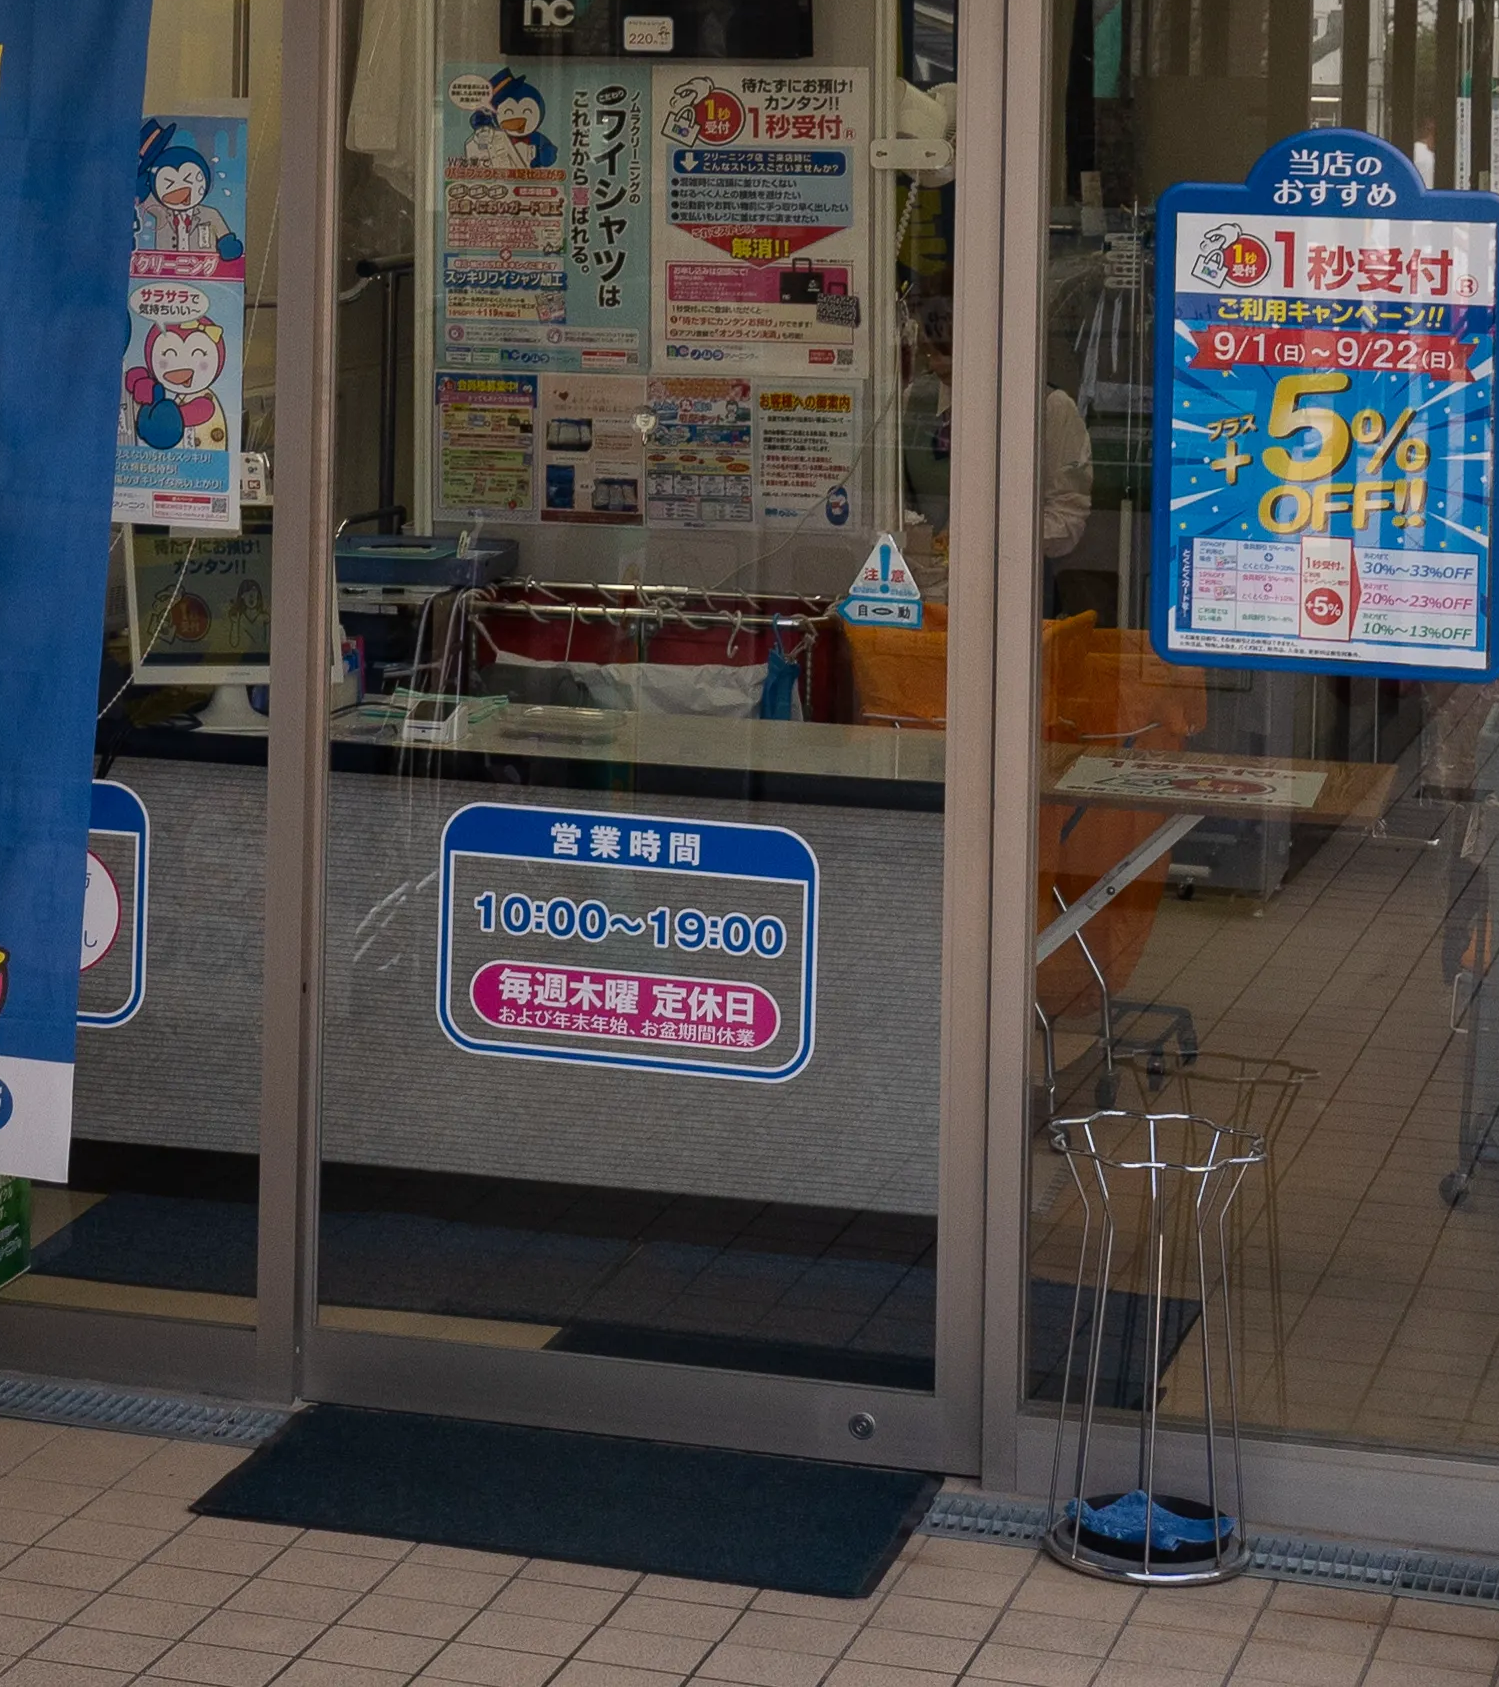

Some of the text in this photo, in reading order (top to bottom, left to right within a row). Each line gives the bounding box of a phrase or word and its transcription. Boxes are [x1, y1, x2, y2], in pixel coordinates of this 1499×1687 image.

[741, 78, 853, 94] 待たずにお預け!
[765, 96, 839, 111] カンタン!!
[630, 91, 641, 204] ノムラクリーニングの
[703, 163, 838, 173] こんなストレスございませんか?
[1289, 150, 1382, 177] 当店の
[571, 91, 590, 273] これだから喜ばれる。
[1273, 179, 1397, 208] おすすめ
[593, 110, 629, 307] ワイシャツは
[731, 237, 791, 259] 解消!!
[1232, 244, 1258, 263] 1秒
[445, 272, 564, 287] スッキリワイシャツ加工
[1232, 264, 1257, 278] 受付
[141, 288, 200, 303] サラサラで
[1218, 298, 1443, 328] ご利用キャンペーン!!
[1207, 414, 1258, 441] プラス
[1258, 478, 1427, 534] OFF!!
[864, 568, 905, 582] 注意
[858, 605, 910, 619] 自動
[551, 822, 701, 866] 営業時間
[498, 968, 755, 1024] 毎週木曜 定休日
[498, 1006, 755, 1046] および年末年始、お盆期間休業
